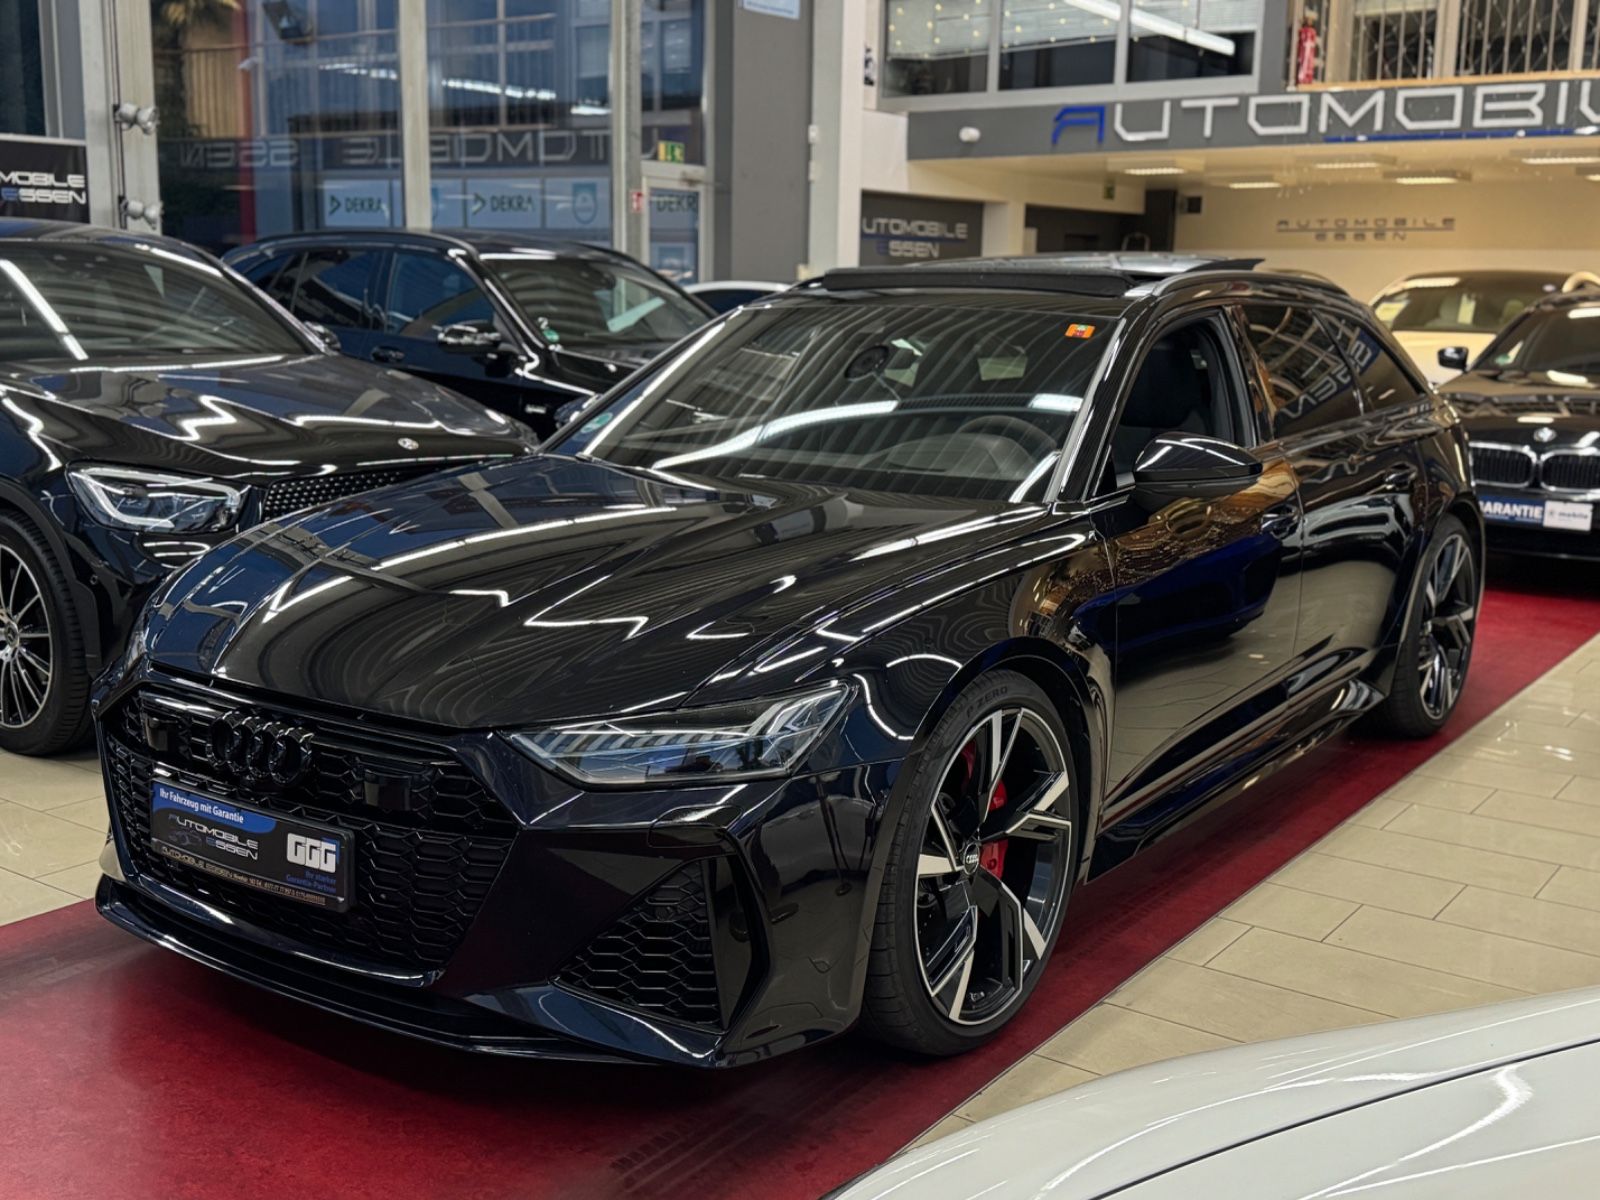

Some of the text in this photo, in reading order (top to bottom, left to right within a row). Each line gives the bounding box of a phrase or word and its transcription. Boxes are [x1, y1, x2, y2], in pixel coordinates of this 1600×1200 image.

[0, 187, 87, 205] ESSEN
[489, 194, 535, 213] DEKRA
[1276, 217, 1456, 230] AUTOMOBILE
[876, 239, 940, 258] ESSEN
[160, 787, 245, 824] Ihr Fahrzeug mit Garantie
[168, 813, 259, 850] AUTOMOBILE
[206, 836, 259, 861] ESSEN
